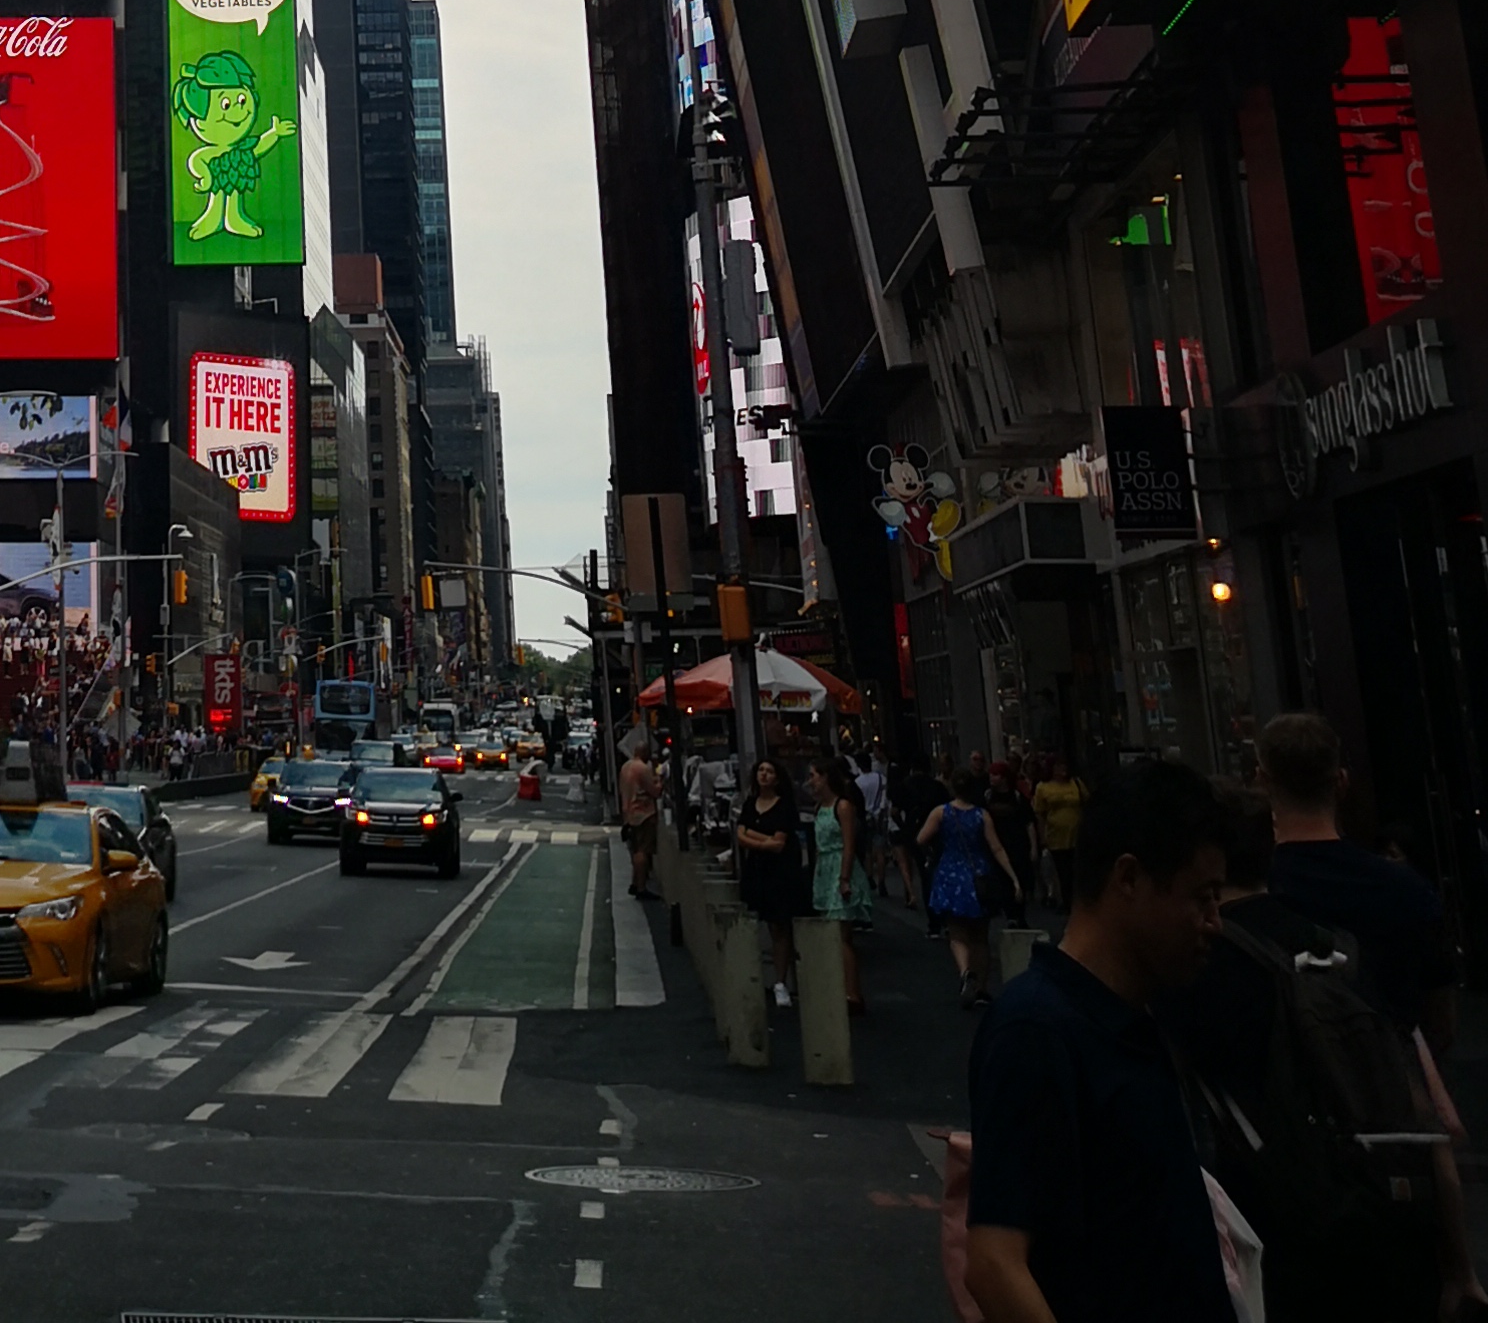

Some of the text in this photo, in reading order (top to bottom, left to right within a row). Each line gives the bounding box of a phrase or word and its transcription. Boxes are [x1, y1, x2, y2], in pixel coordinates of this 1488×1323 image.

[205, 371, 282, 400] EXPERIENCE
[1305, 317, 1454, 474] sunglass hut
[205, 396, 225, 428] IT
[229, 398, 282, 434] HERE
[1114, 450, 1155, 470] U.S.
[1117, 470, 1180, 492] POLO
[1120, 491, 1188, 512] ASSN.
[214, 657, 237, 705] tkts
